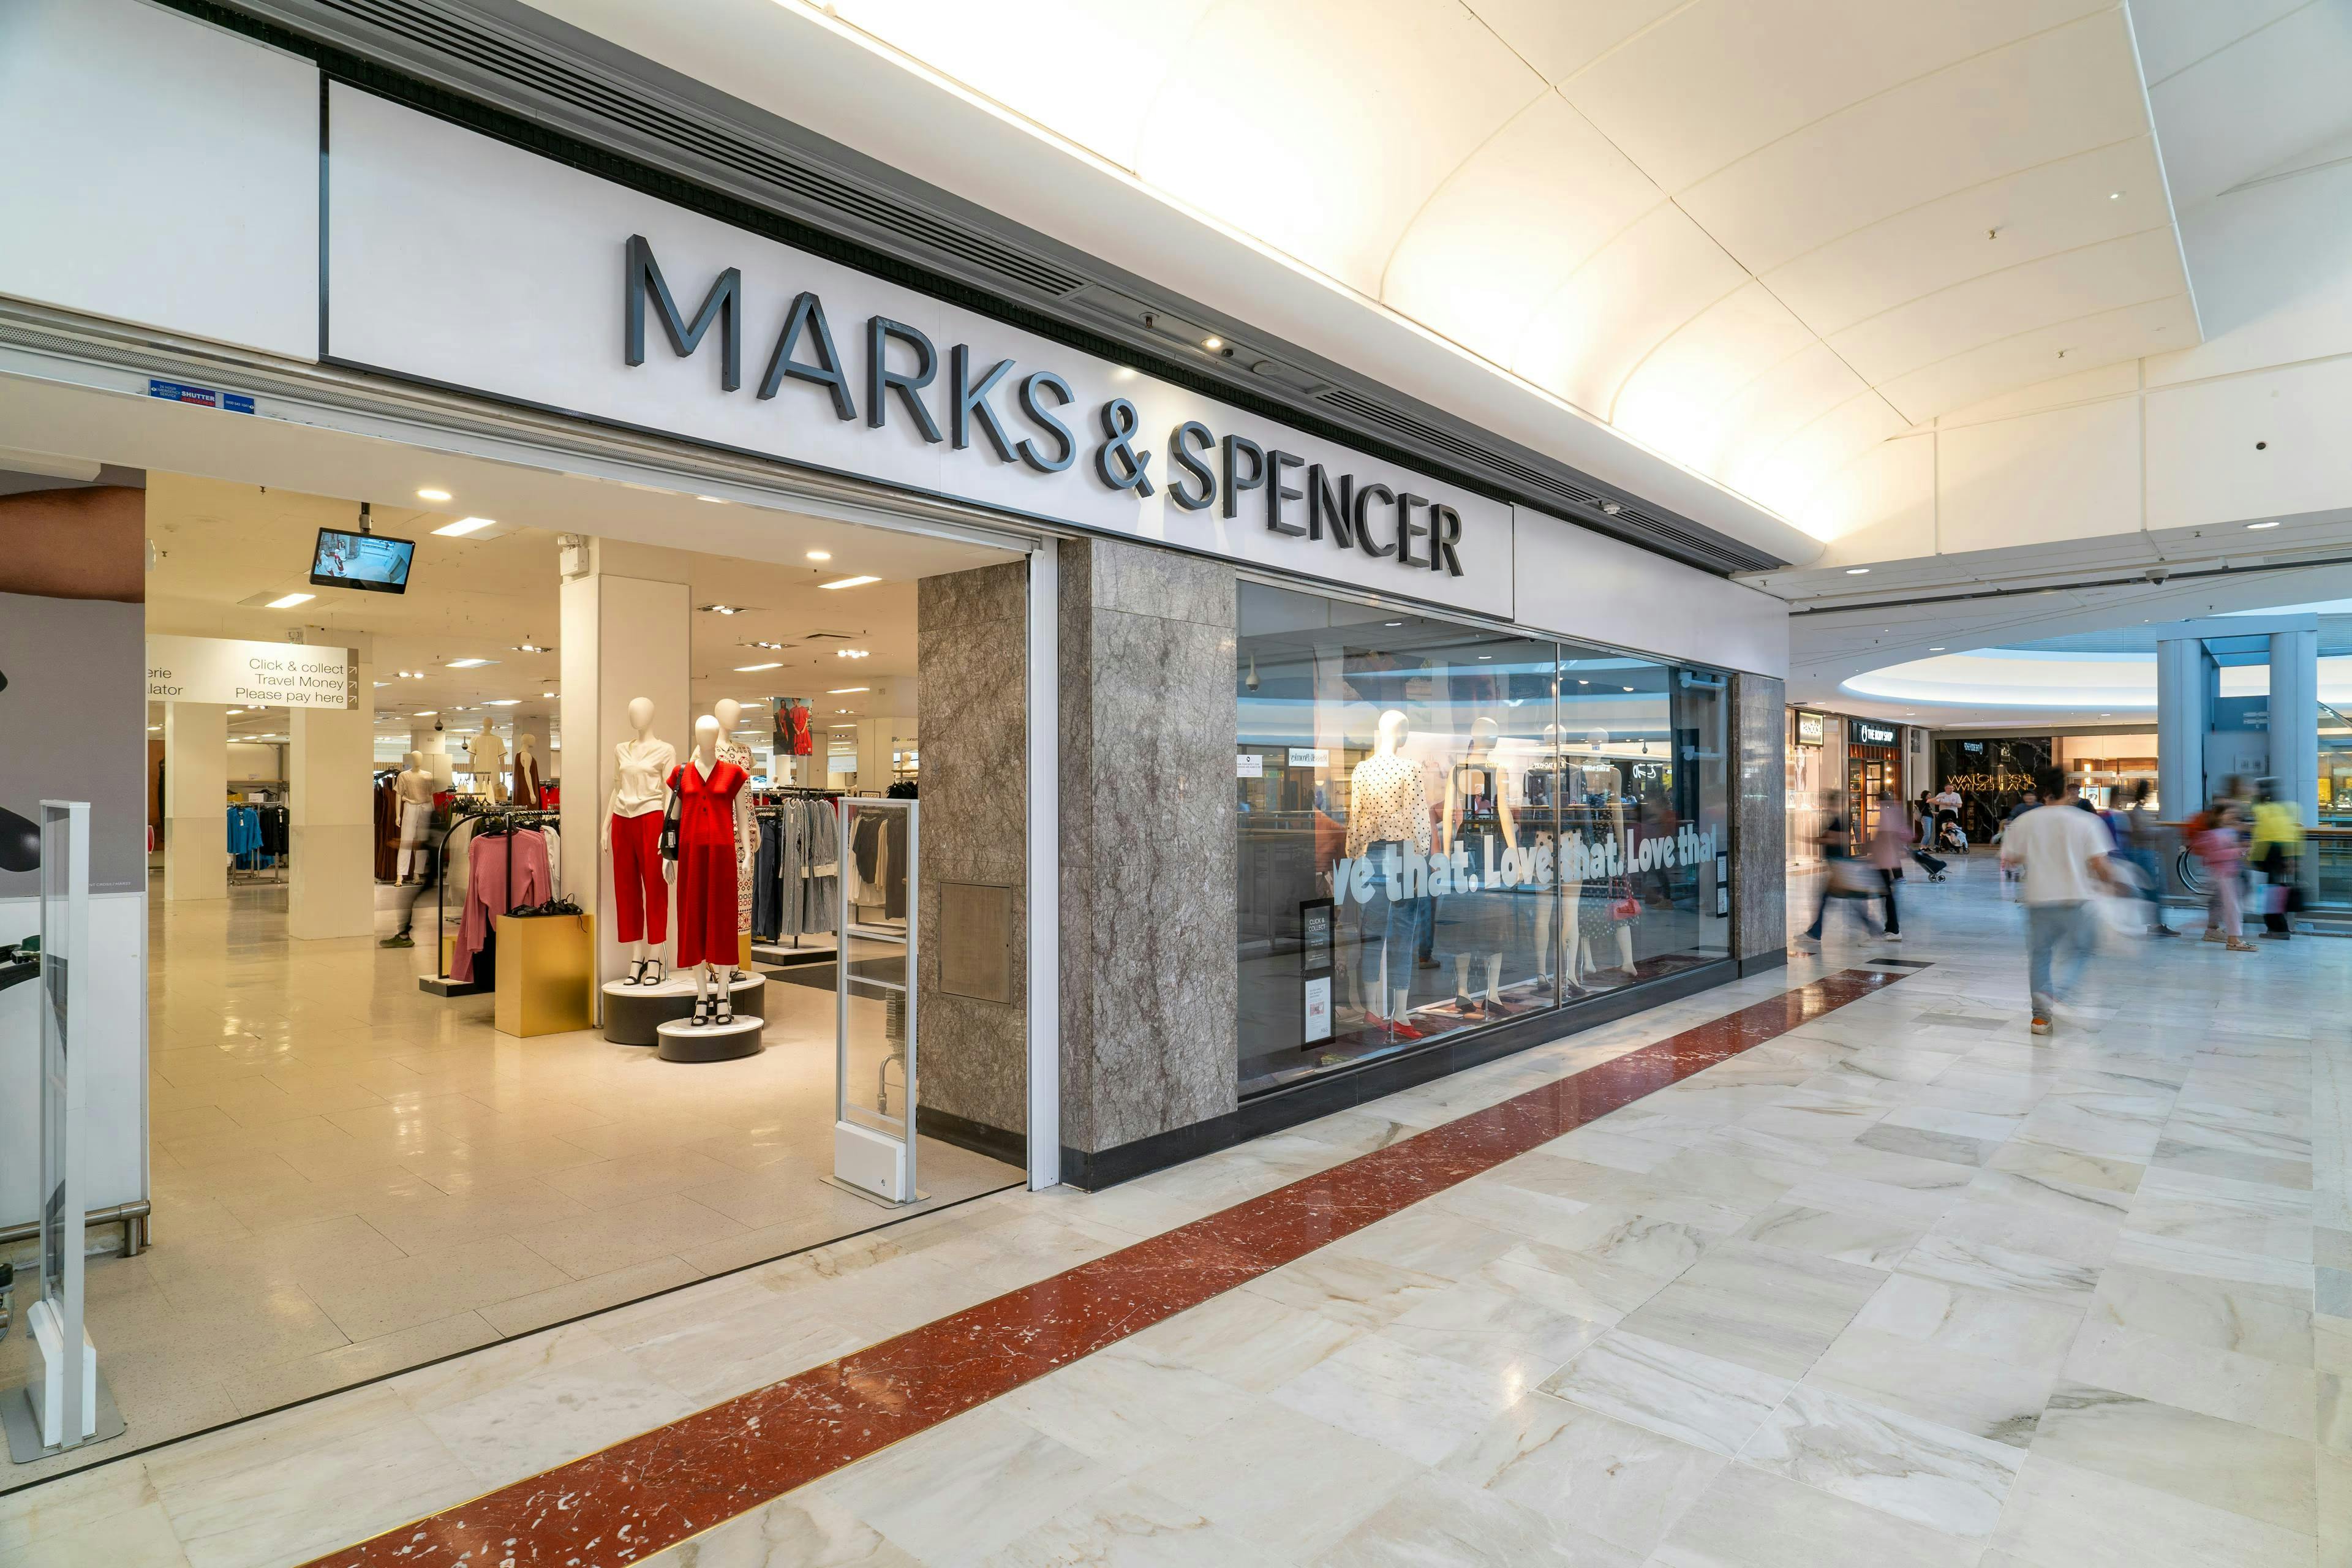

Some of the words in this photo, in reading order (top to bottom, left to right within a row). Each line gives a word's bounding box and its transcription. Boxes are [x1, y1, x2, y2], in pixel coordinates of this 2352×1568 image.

[181, 391, 215, 402] SHUTTER
[625, 234, 1077, 473] MARKS
[1094, 397, 1153, 497] &
[1166, 420, 1464, 577] SPENCER
[249, 658, 284, 671] Click
[287, 661, 297, 672] &
[301, 663, 344, 674] collect
[148, 683, 184, 695] lator
[255, 674, 295, 686] Travel
[300, 676, 344, 690] Money
[236, 687, 282, 700] Please
[287, 692, 311, 704] pay
[315, 692, 344, 703] here
[1947, 774, 2021, 784] WATCHES
[1382, 840, 1479, 902] that.
[1484, 834, 1554, 889] Love
[1560, 832, 1624, 883] that.
[1627, 828, 1675, 873] Love
